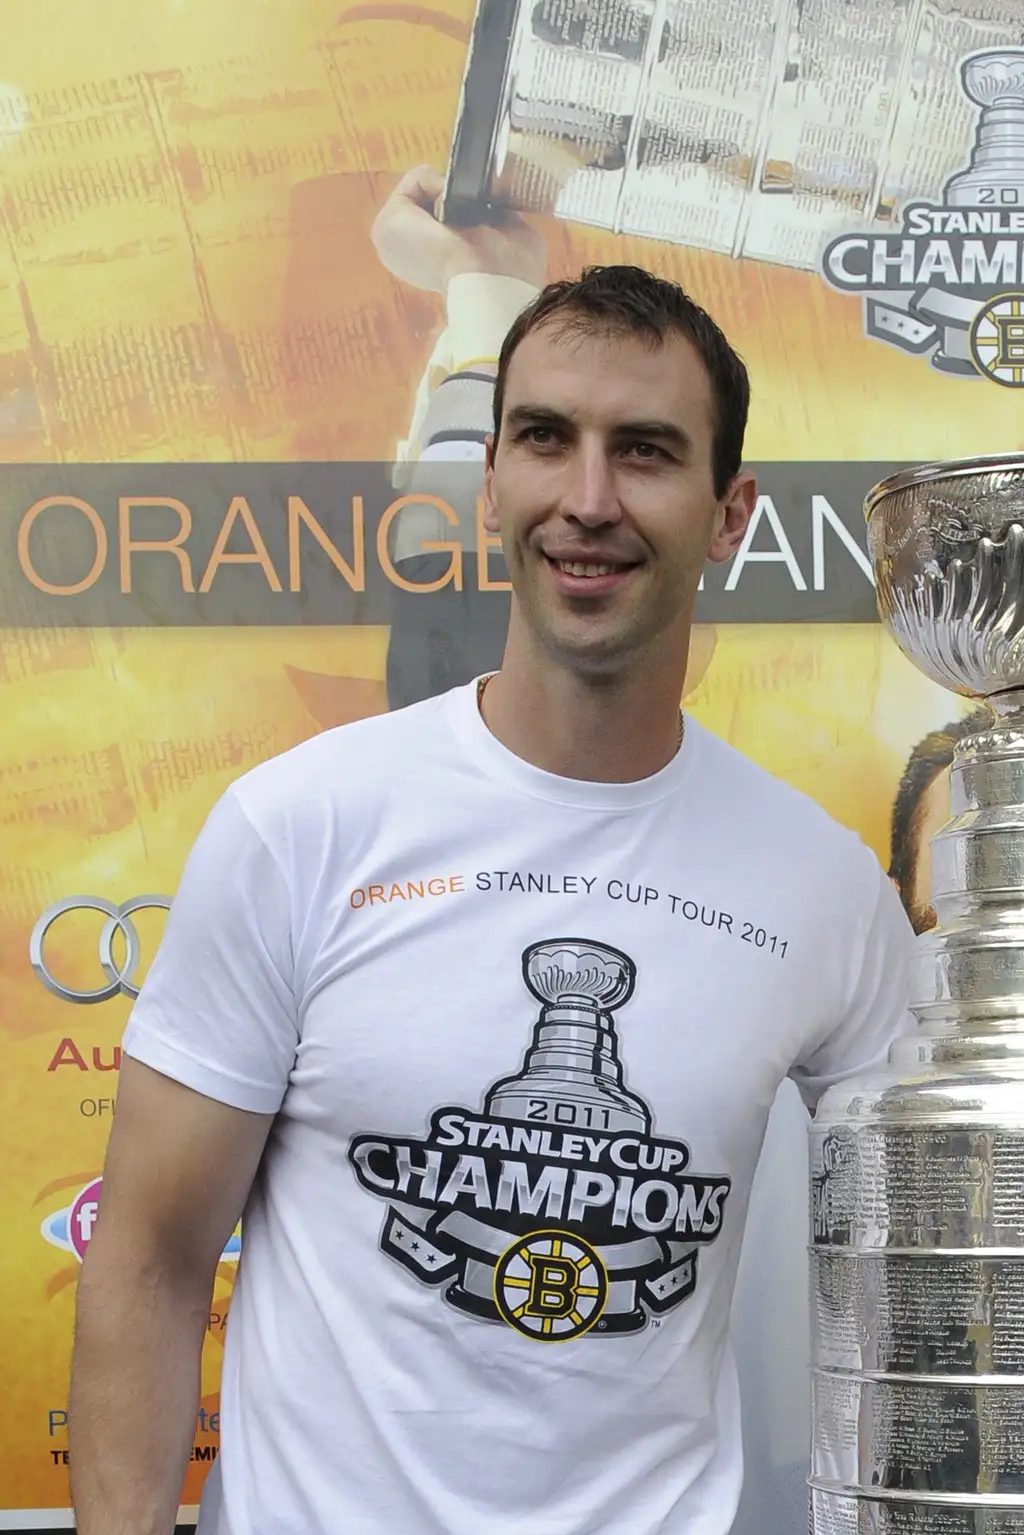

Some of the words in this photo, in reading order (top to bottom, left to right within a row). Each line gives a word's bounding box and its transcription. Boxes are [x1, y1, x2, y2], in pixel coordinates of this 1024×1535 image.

[349, 874, 466, 910] ORANGE
[475, 870, 598, 895] STANLEY
[606, 880, 660, 906] CUP
[668, 893, 734, 934] TOUR
[741, 921, 789, 959] 2011
[47, 1038, 122, 1072] Au
[435, 1114, 606, 1163] STANLEY
[609, 1138, 685, 1173] CUP
[526, 1100, 611, 1130] 2011
[352, 1141, 730, 1236] CHAMPIONS
[525, 1256, 579, 1319] B
